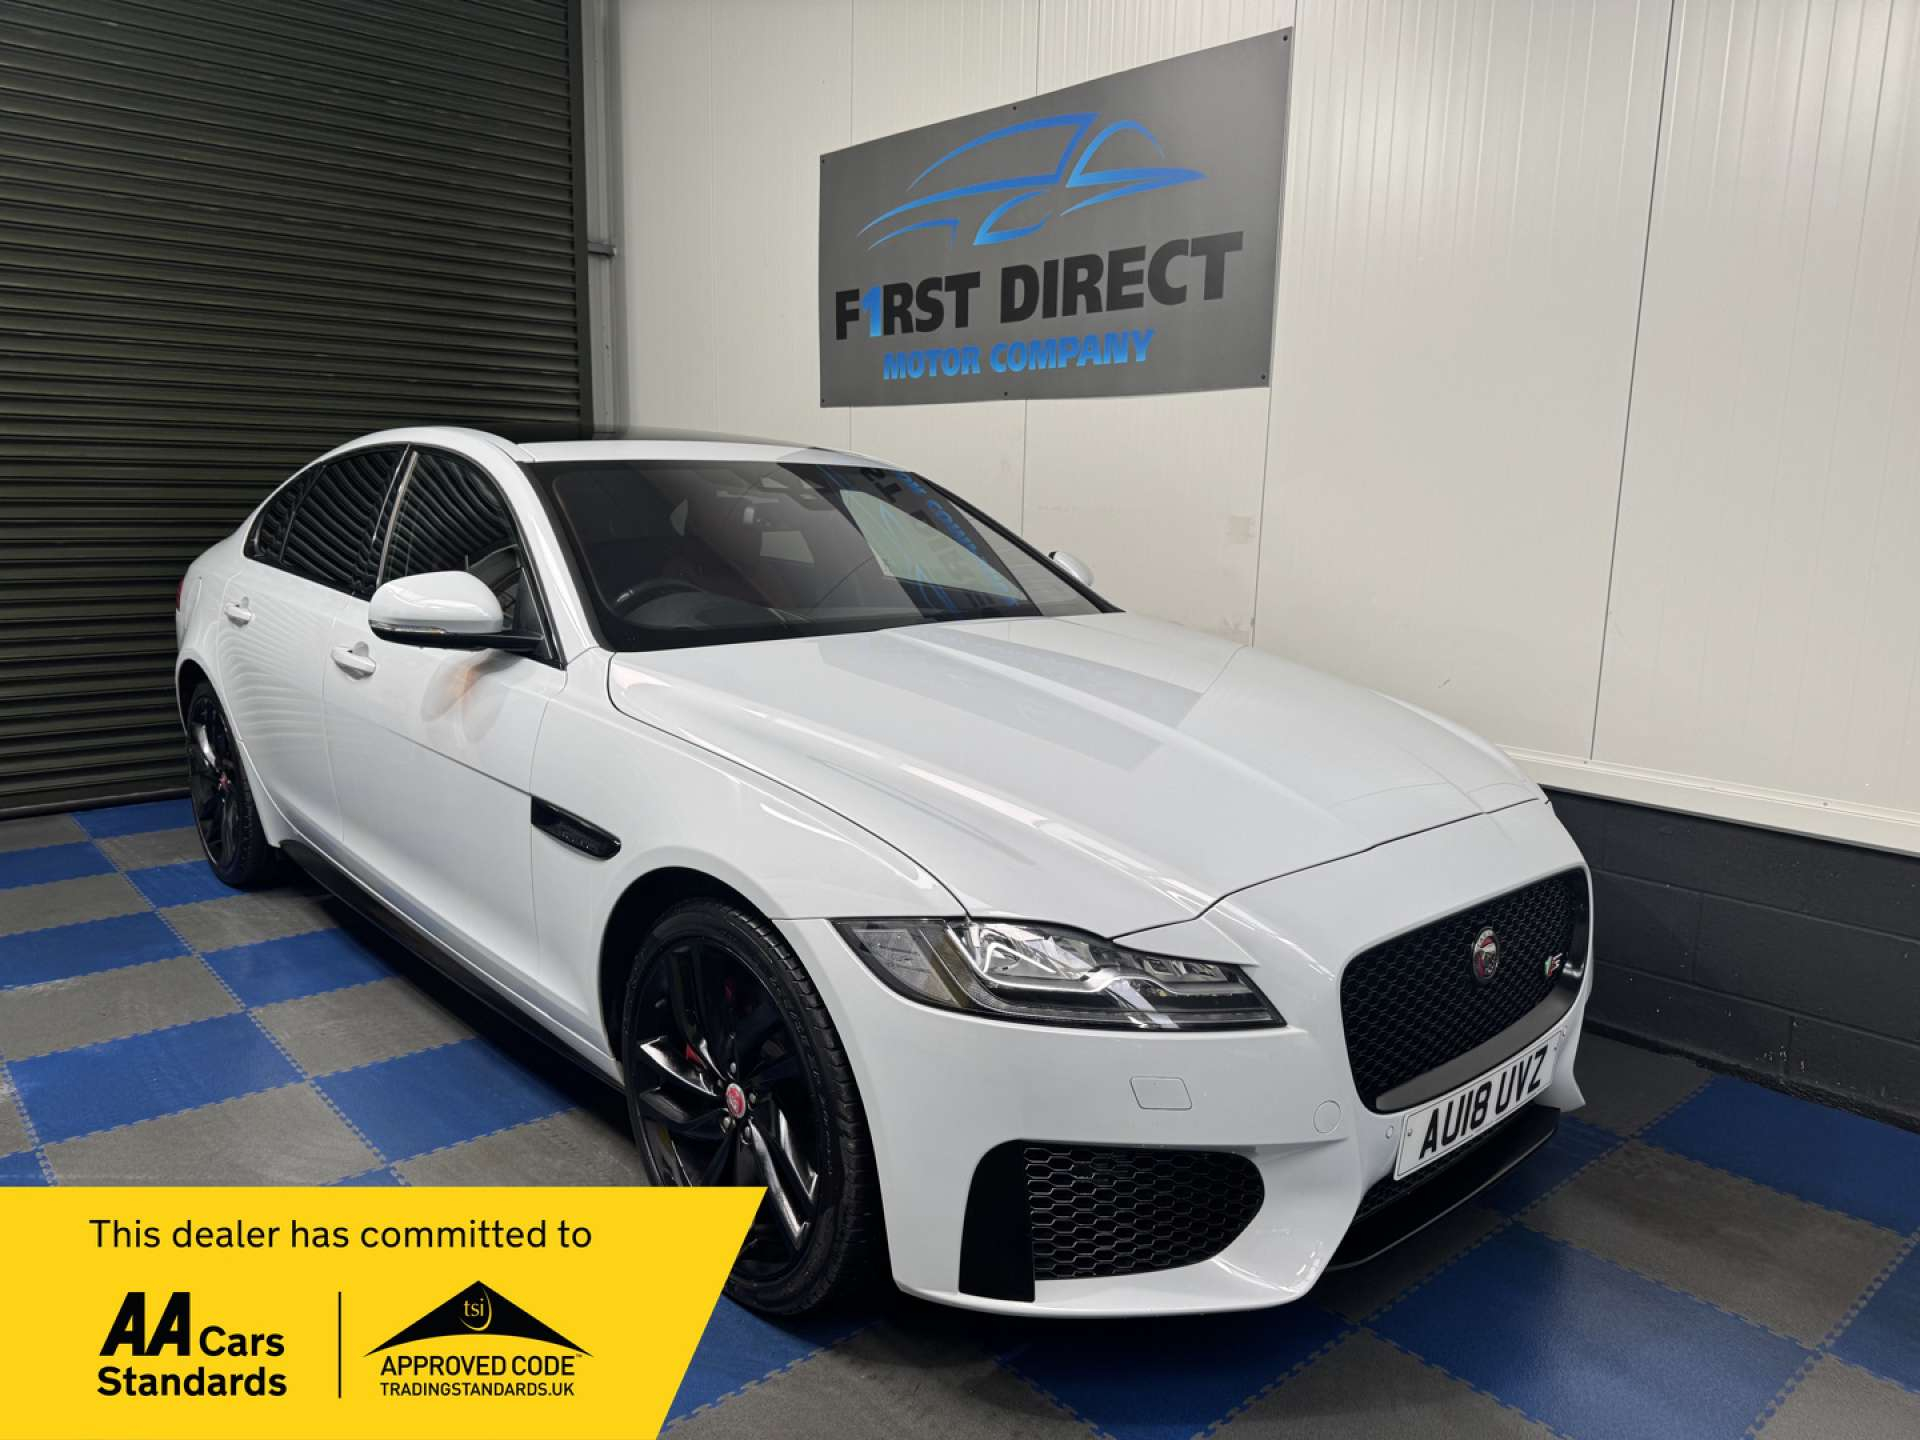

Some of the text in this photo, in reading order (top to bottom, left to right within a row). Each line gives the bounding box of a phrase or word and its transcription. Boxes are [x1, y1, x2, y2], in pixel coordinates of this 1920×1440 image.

[835, 231, 1244, 340] F1RST DIRECT
[883, 328, 1155, 380] MOTOR COMPANY
[1418, 1045, 1549, 1160] AU18 UVZ
